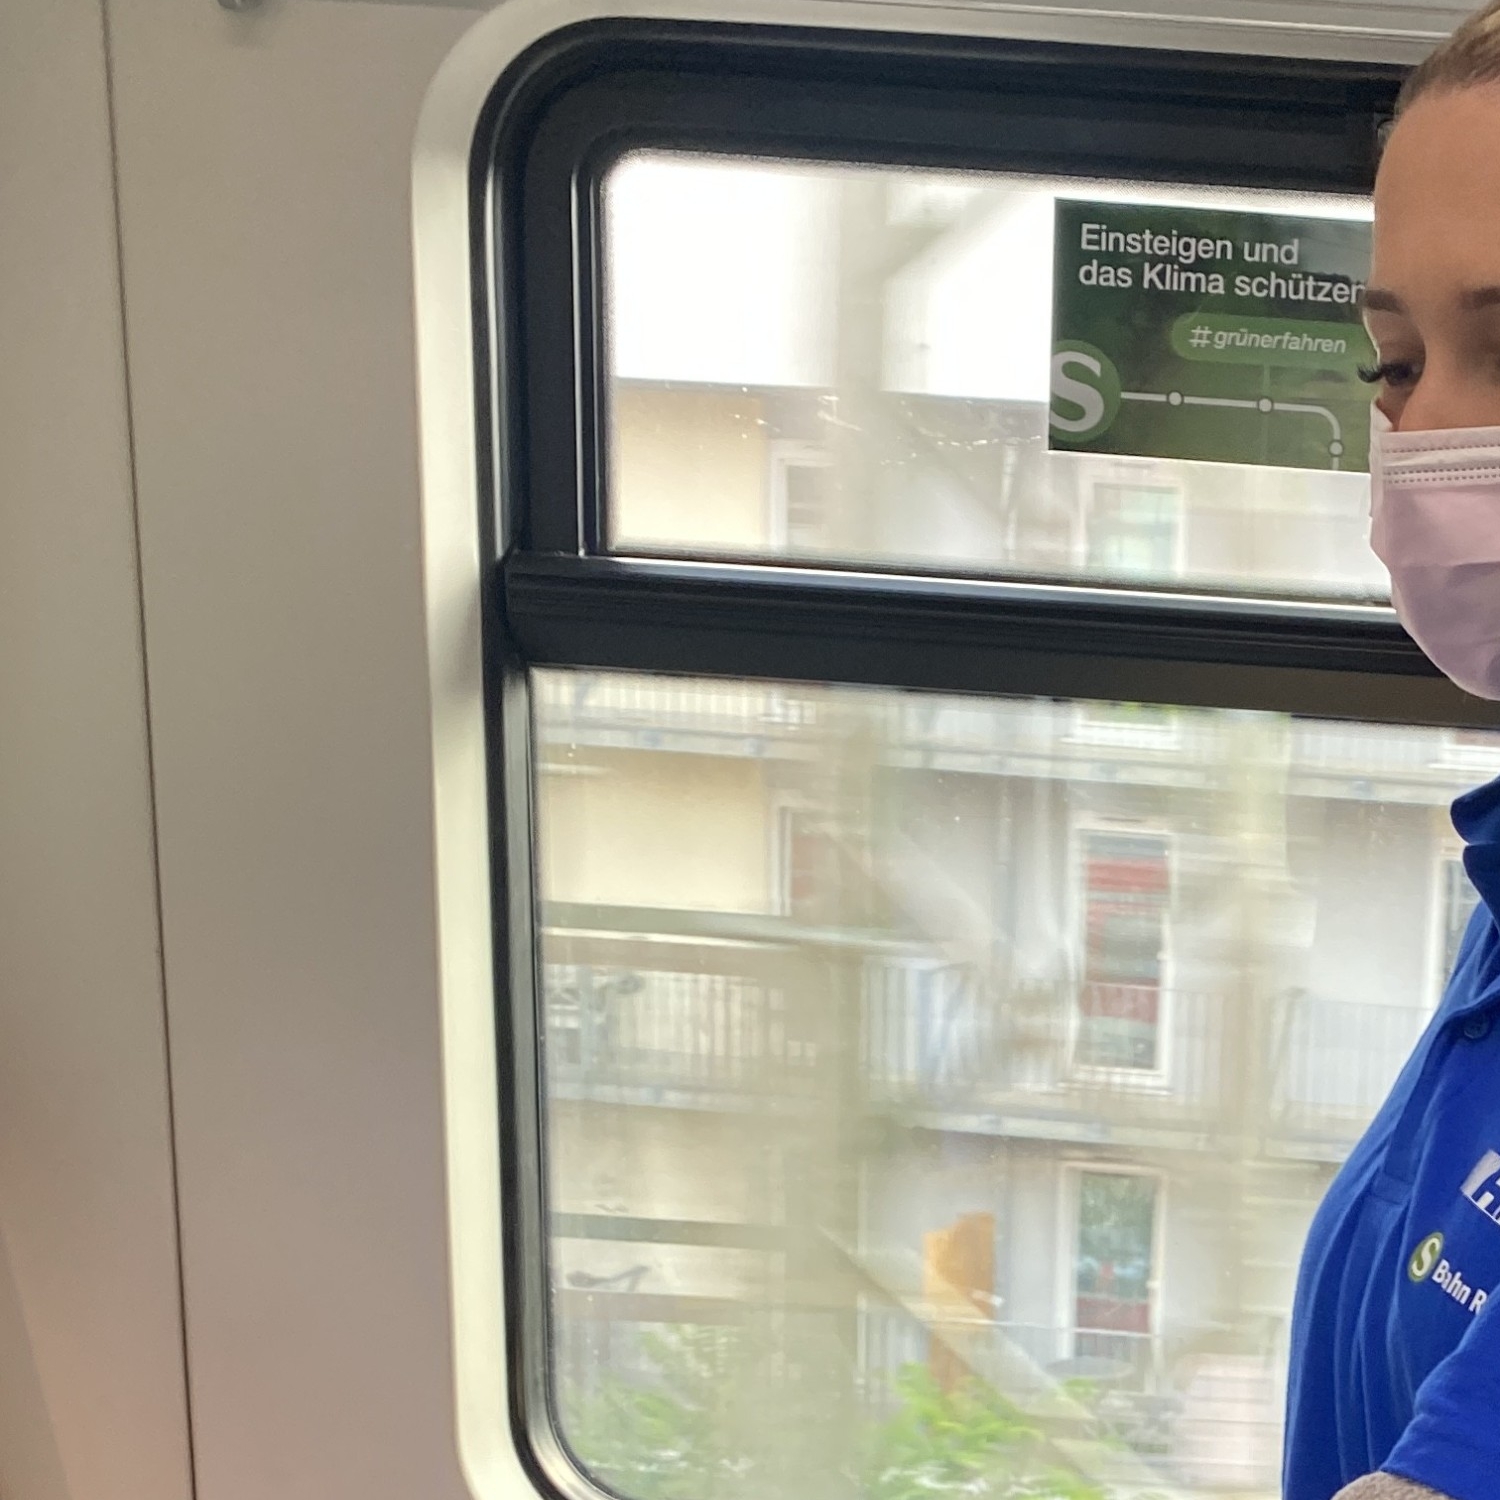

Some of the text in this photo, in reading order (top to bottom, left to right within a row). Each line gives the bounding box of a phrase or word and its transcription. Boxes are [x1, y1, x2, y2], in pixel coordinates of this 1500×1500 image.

[1080, 222, 1300, 265] Einsteigen und
[1078, 260, 1133, 288] das
[1142, 263, 1225, 295] Klima
[1189, 325, 1347, 354] #grünerfahren
[1410, 1236, 1442, 1278] S
[1431, 1258, 1472, 1306] Bahn
